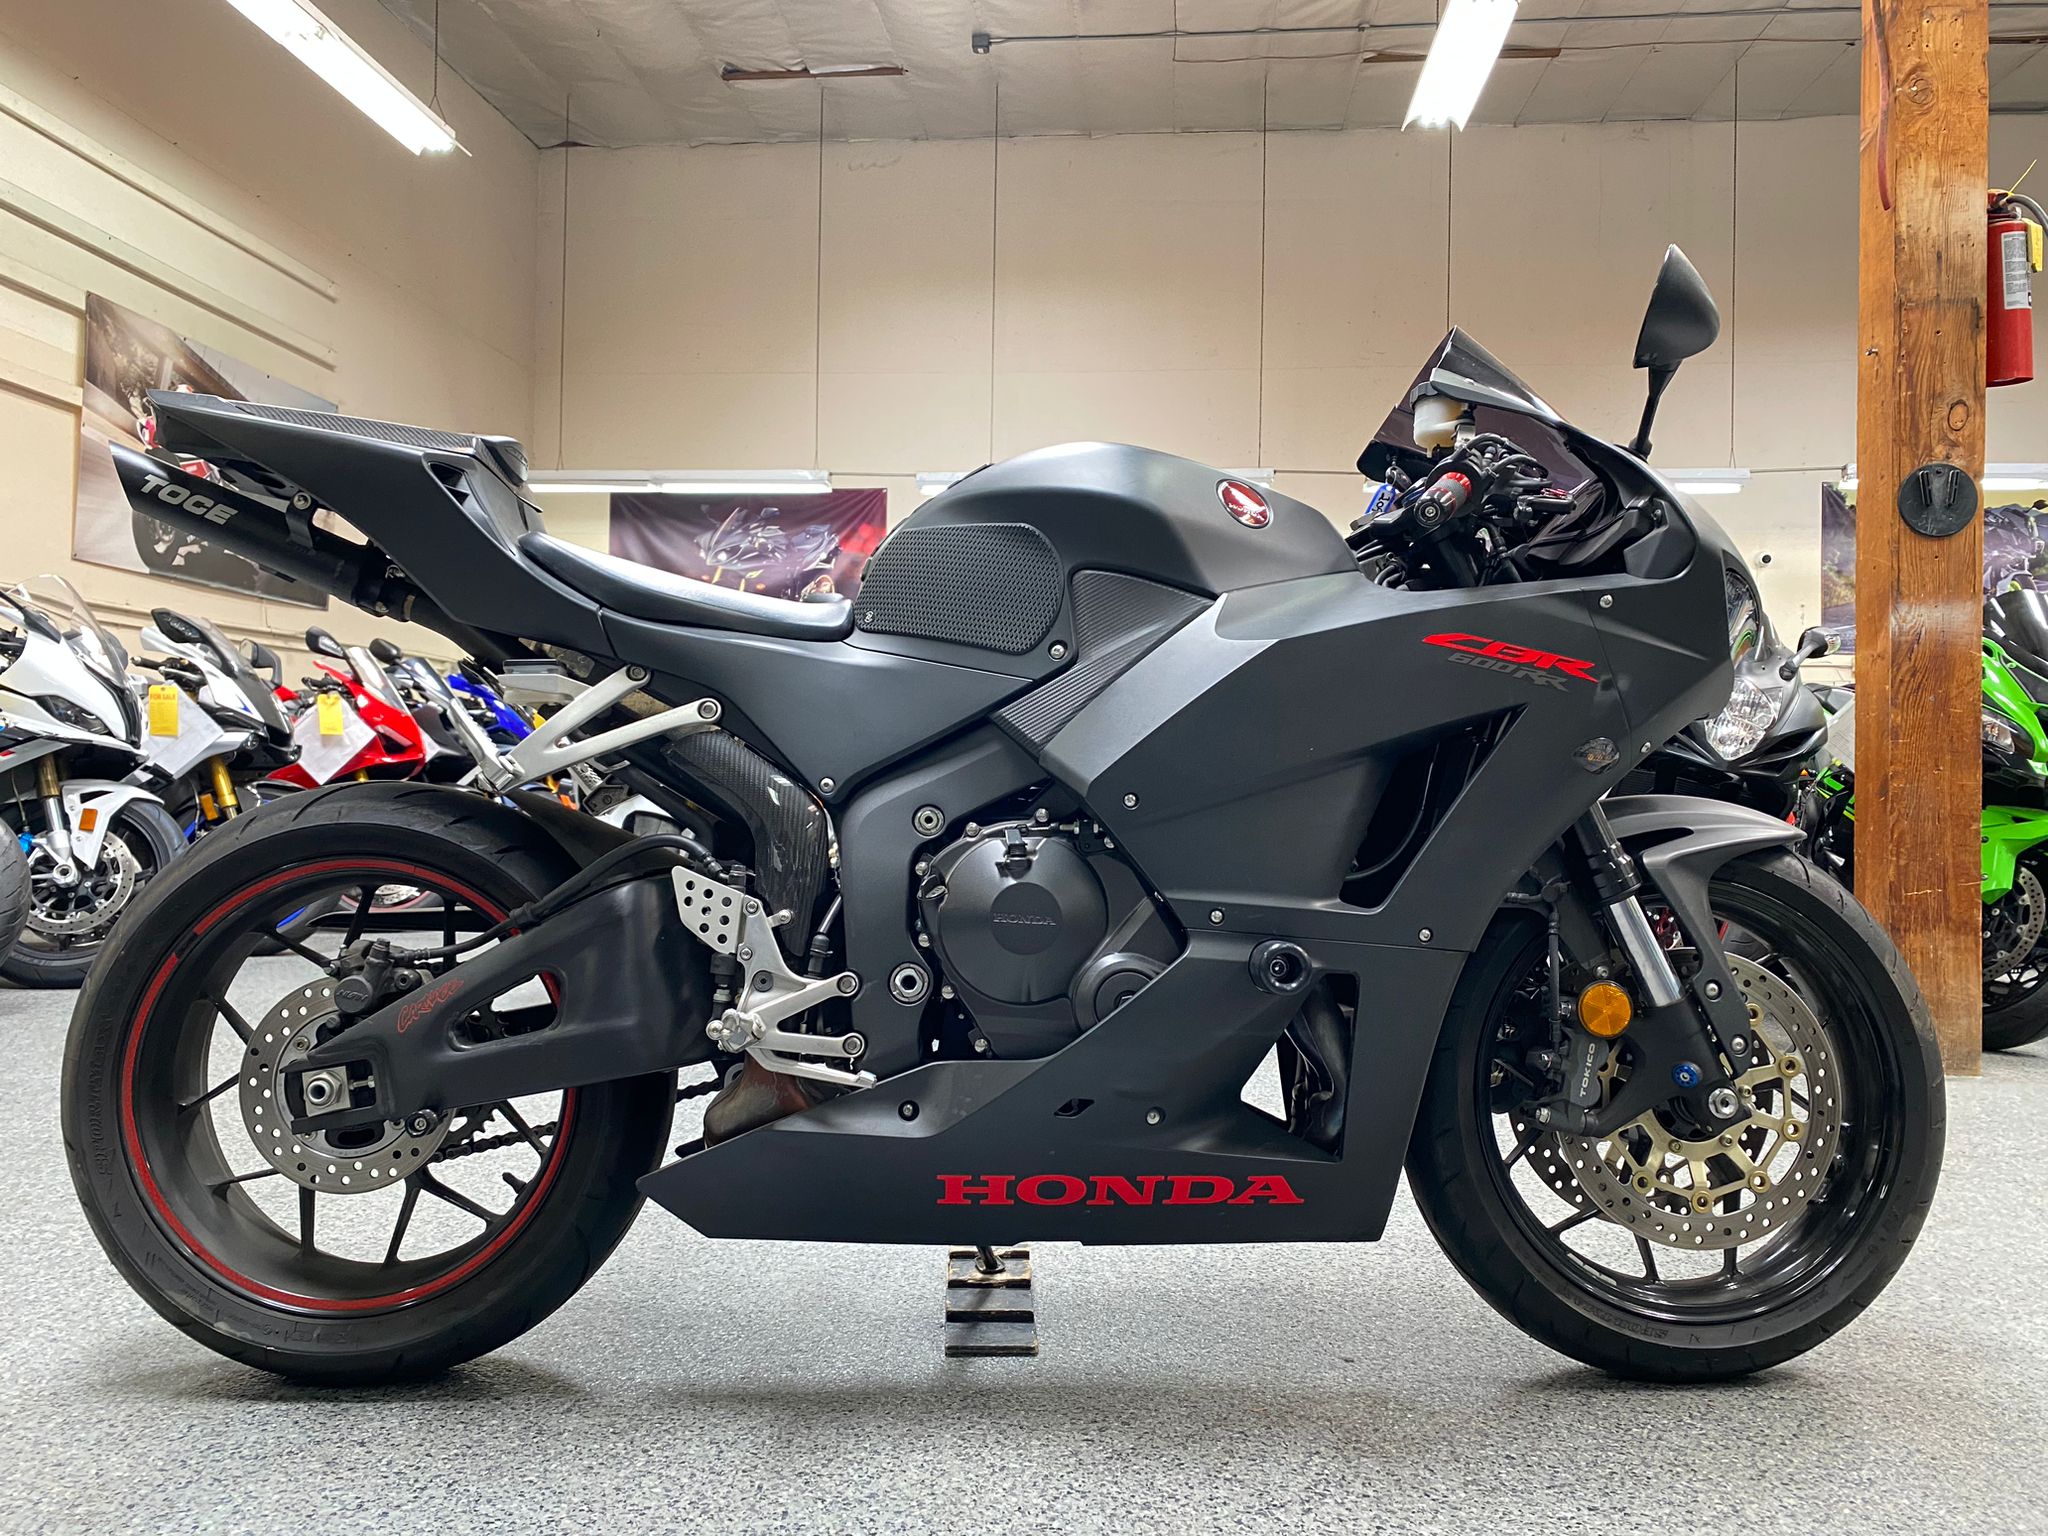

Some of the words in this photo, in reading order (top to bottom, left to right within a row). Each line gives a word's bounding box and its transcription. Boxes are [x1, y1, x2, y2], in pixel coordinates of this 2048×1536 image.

[140, 474, 239, 525] TOCE
[1422, 632, 1599, 684] CBR
[1448, 652, 1569, 693] 600RR
[993, 911, 1057, 926] HONDA
[1579, 1042, 1596, 1098] TOKICO
[936, 1174, 1305, 1205] HONDA
